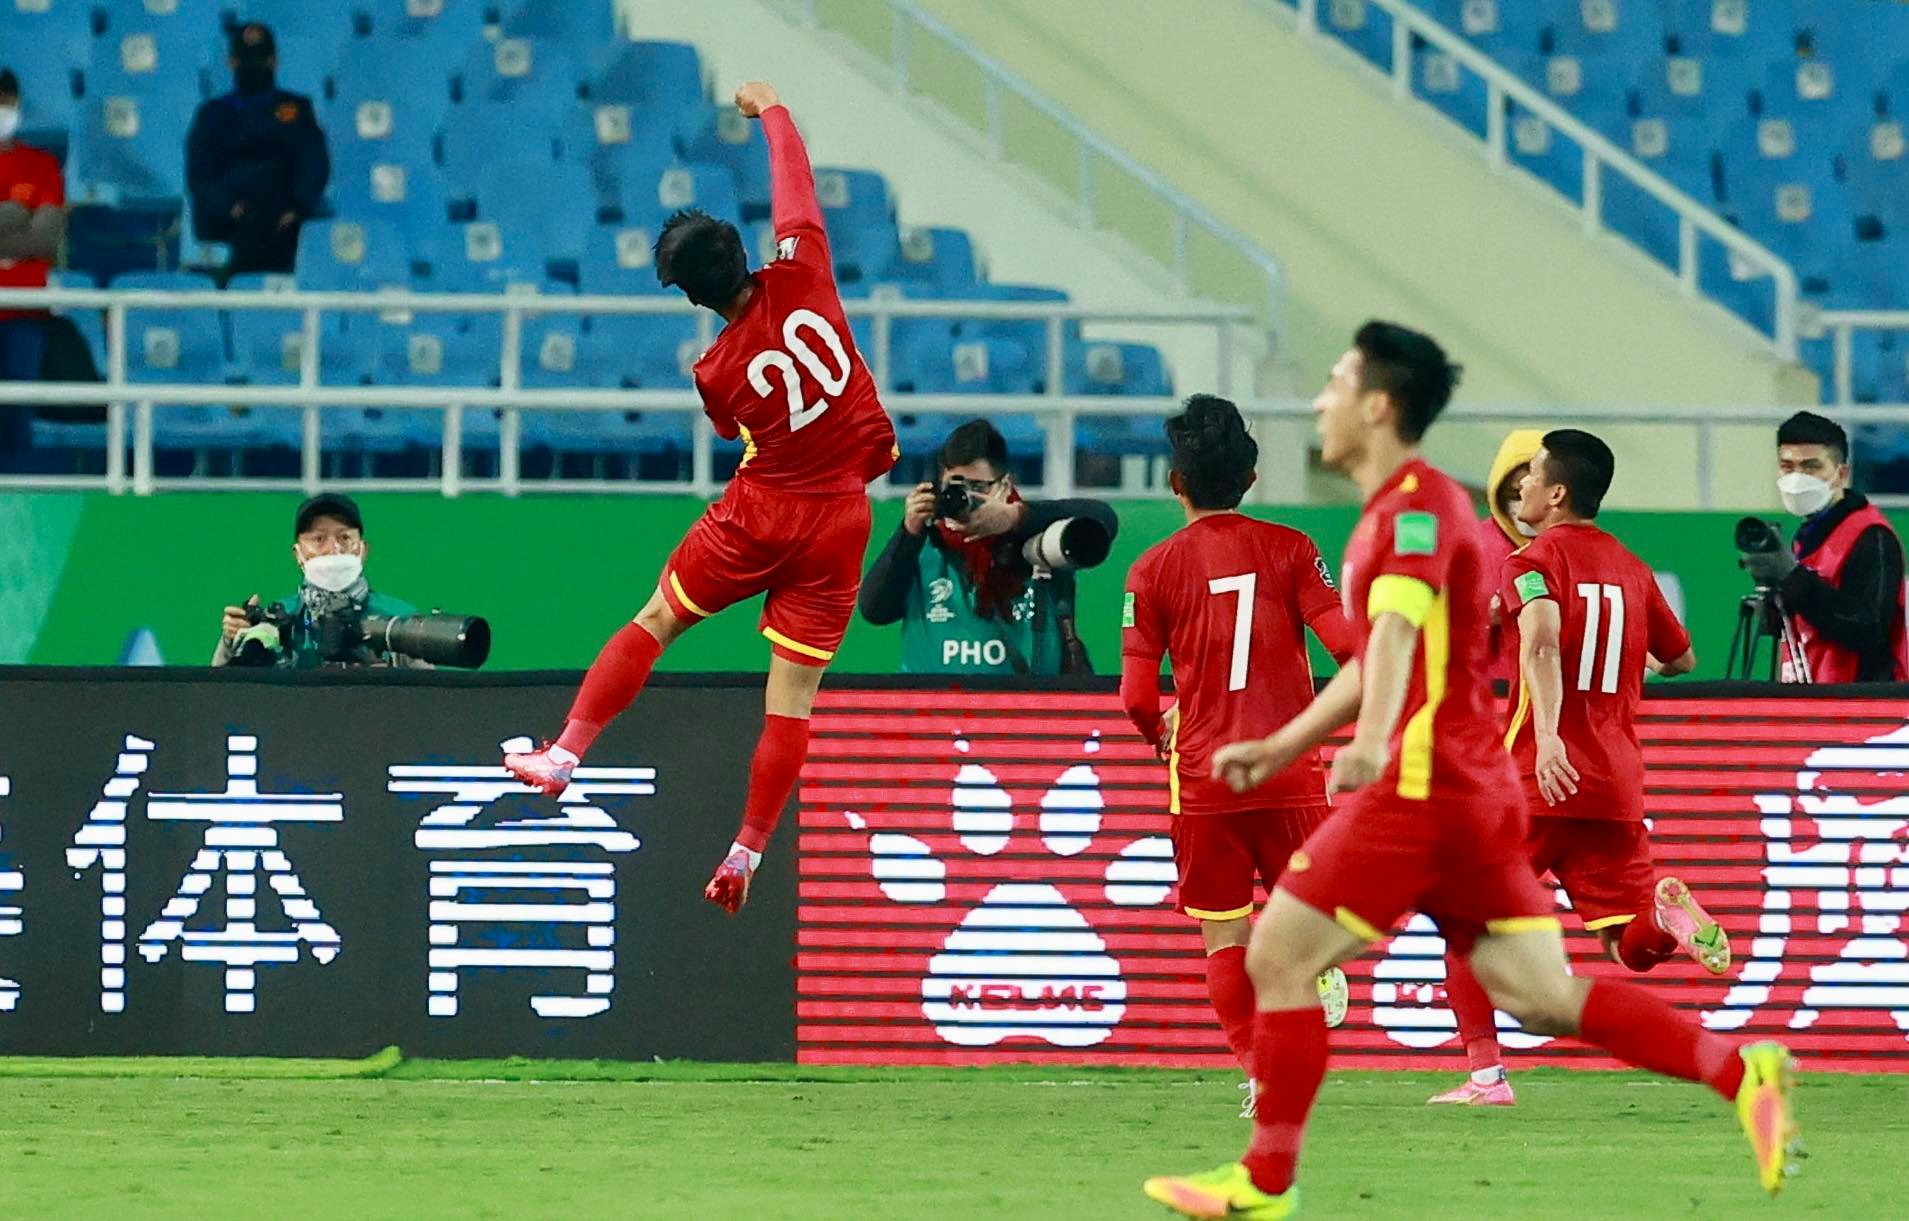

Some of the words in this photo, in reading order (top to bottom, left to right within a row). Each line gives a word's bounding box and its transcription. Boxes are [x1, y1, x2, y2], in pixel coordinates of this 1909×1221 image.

[747, 308, 851, 432] 20
[943, 639, 1006, 665] PHO
[1208, 573, 1256, 692] 7
[1578, 583, 1625, 694] 11
[0, 734, 656, 1018] 体育
